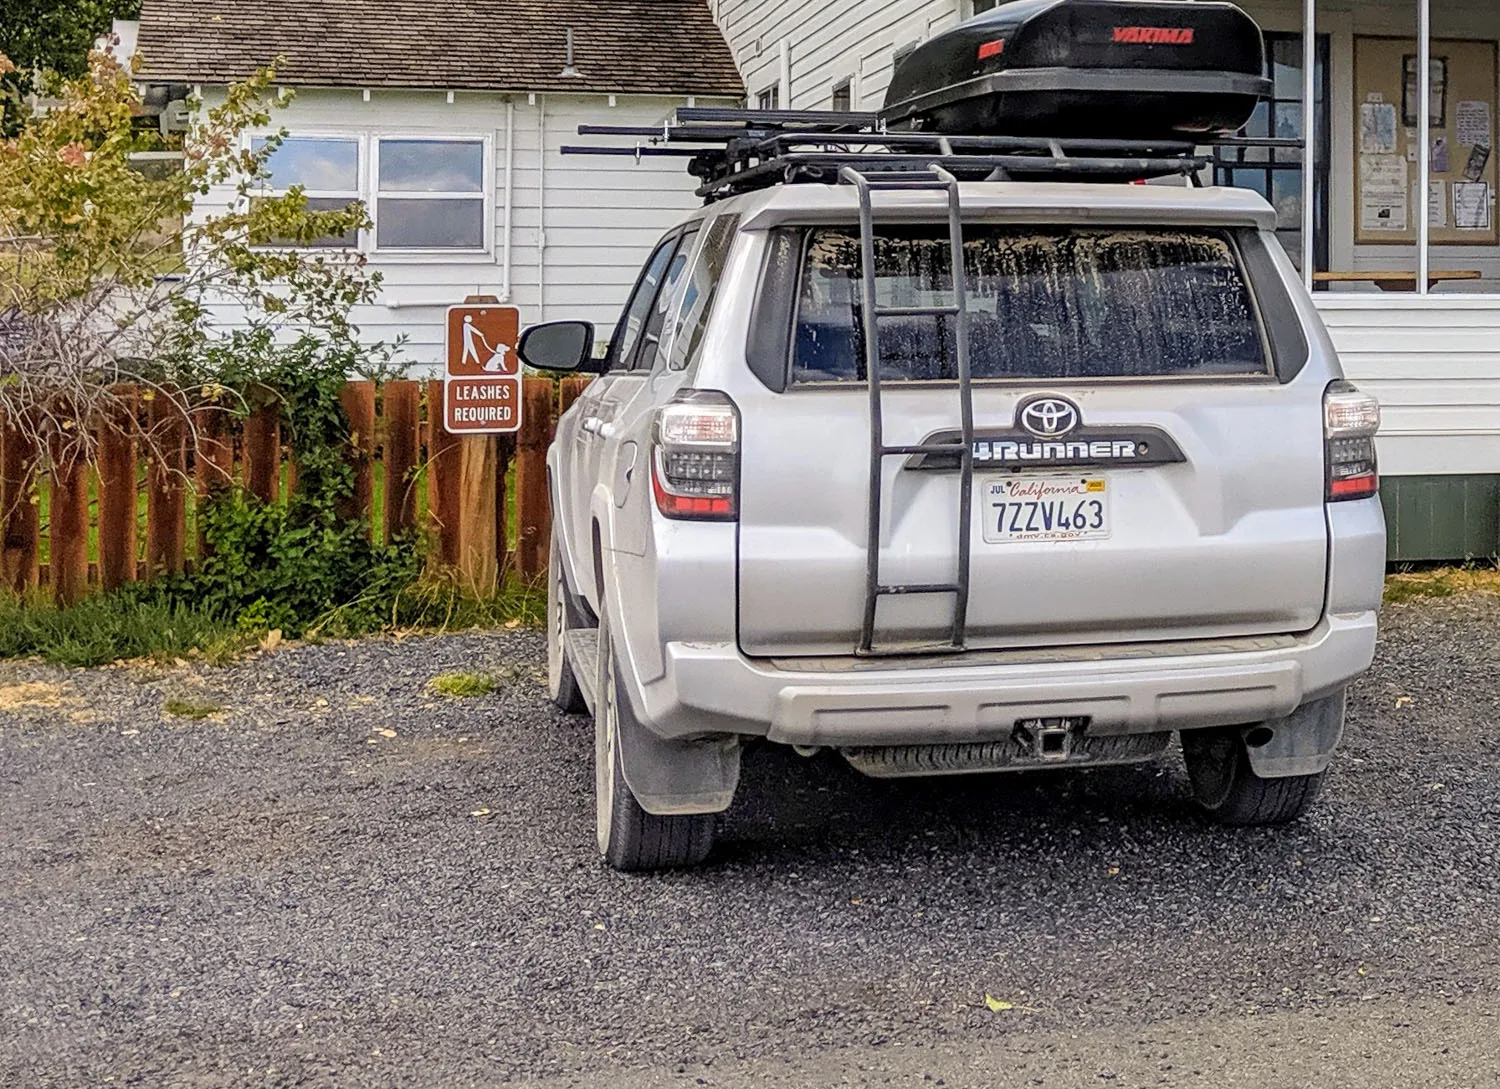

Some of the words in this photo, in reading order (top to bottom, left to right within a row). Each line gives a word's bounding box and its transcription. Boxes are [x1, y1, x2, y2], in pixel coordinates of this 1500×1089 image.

[1112, 26, 1194, 44] YAKIMA
[456, 385, 510, 401] LEASHES
[454, 406, 511, 422] REQUIRED
[990, 485, 1005, 495] JUL
[1009, 481, 1089, 500] California
[992, 500, 1103, 533] 7ZZV463
